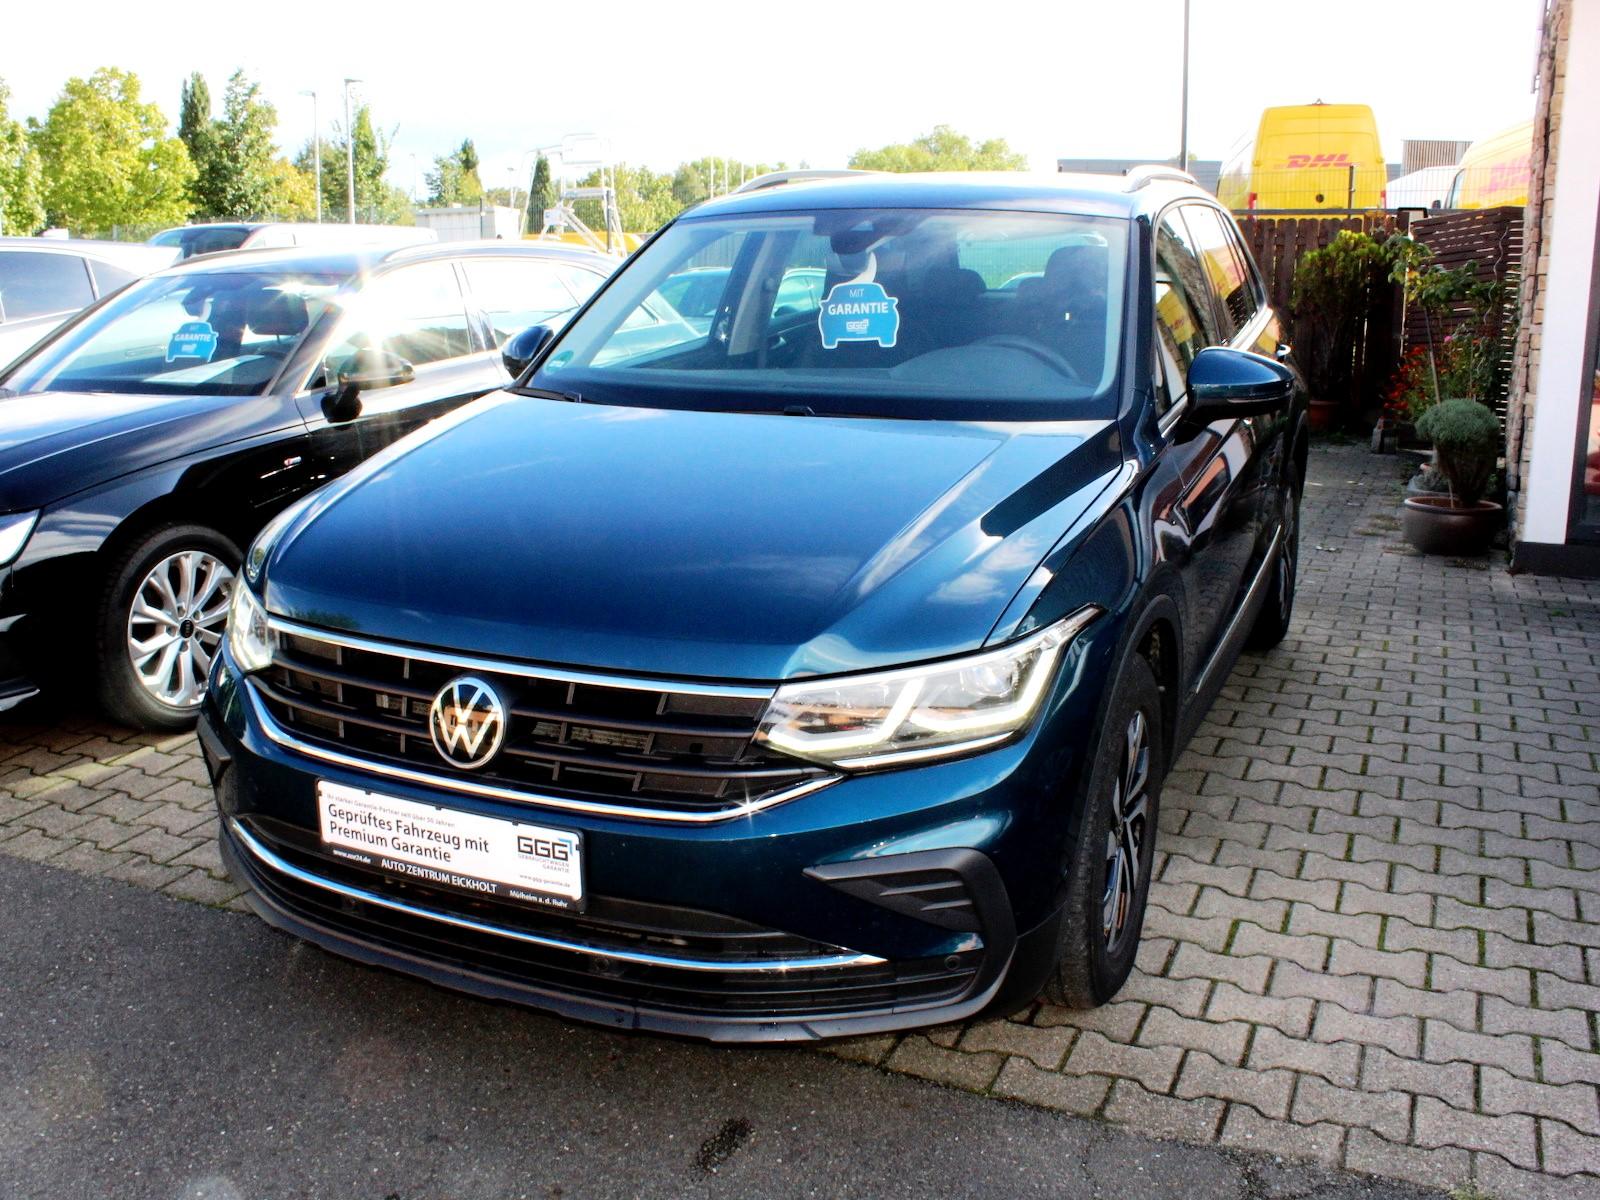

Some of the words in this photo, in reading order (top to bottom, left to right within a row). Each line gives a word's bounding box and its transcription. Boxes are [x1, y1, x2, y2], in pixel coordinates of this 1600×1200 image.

[1286, 153, 1353, 169] DHL
[849, 288, 865, 298] MIT
[828, 302, 889, 316] GARANTIE
[174, 333, 212, 342] GARANTIE
[328, 803, 392, 831] Geprüftes
[396, 820, 461, 850] Fahrzeug
[465, 837, 489, 853] mit
[330, 820, 388, 847] Premium
[391, 836, 451, 863] Garantie
[517, 835, 569, 861] GGG
[381, 859, 406, 873] AUTO
[406, 865, 450, 883] ZENTRUM
[451, 875, 498, 894] EICKHOLT
